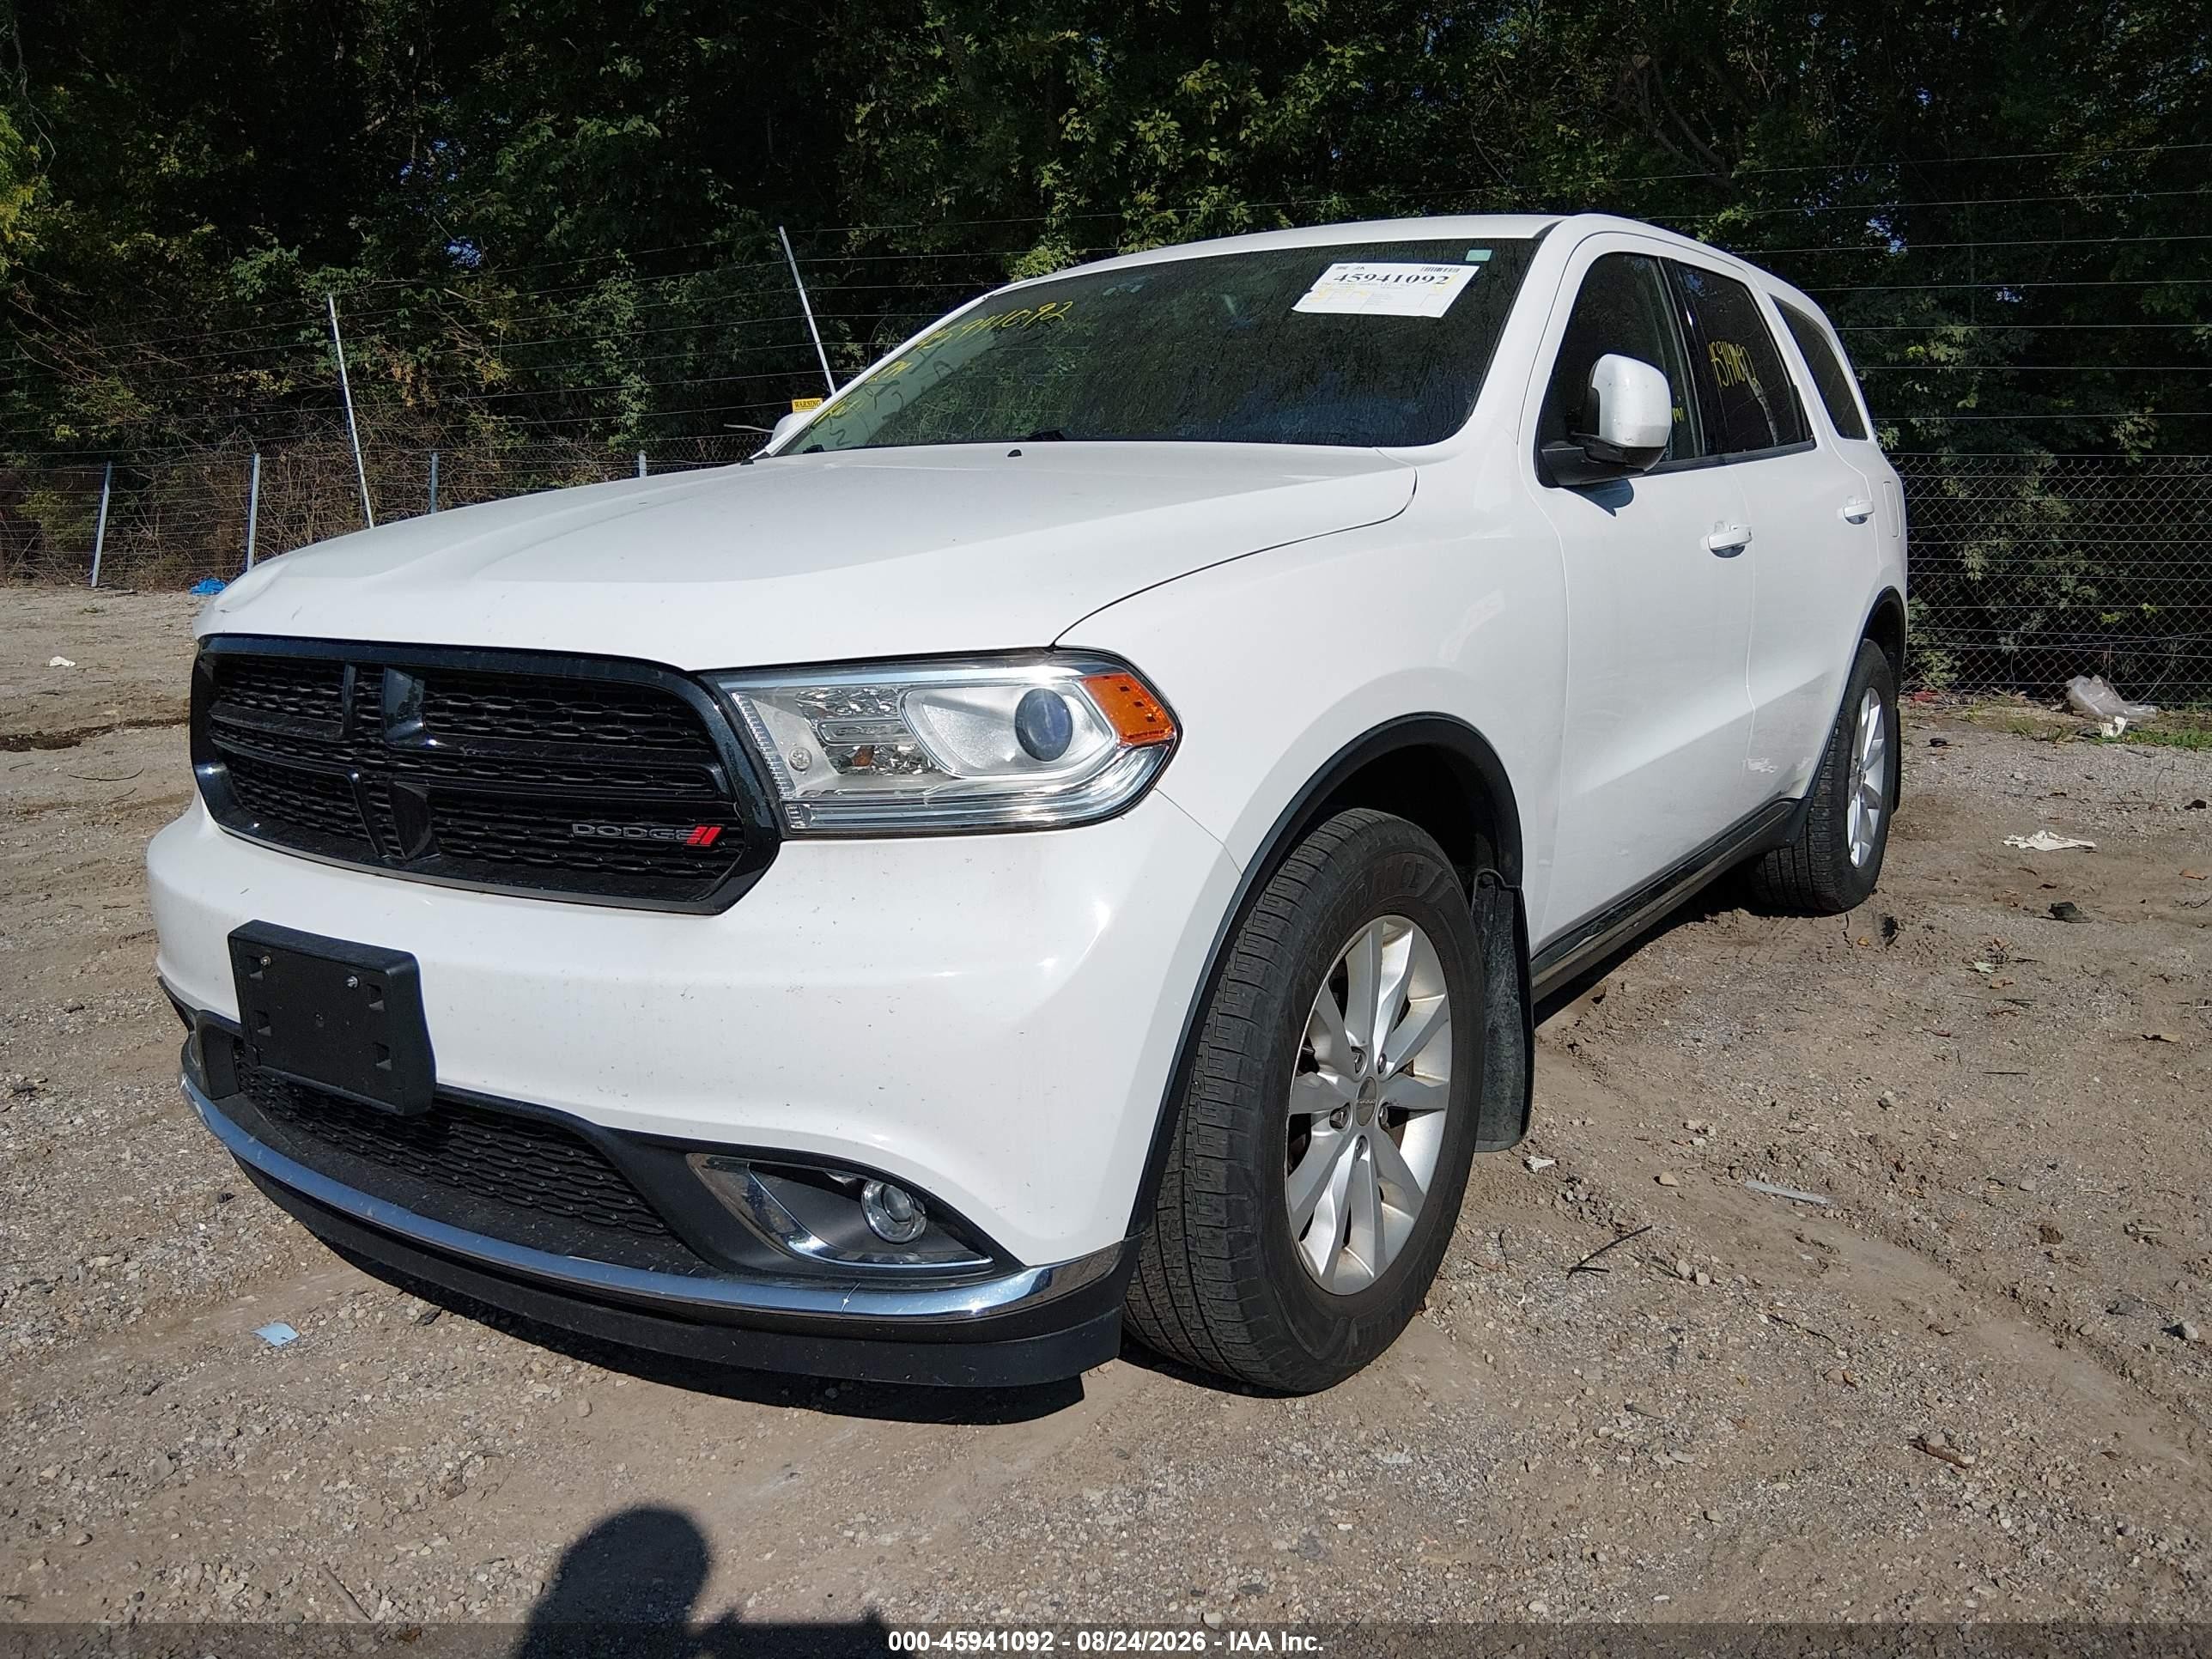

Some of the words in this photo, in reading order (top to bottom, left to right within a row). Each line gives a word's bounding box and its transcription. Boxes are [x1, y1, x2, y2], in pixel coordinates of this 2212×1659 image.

[1333, 272, 1450, 285] 45941092
[794, 399, 821, 408] WARNING
[572, 823, 701, 841] DODGE
